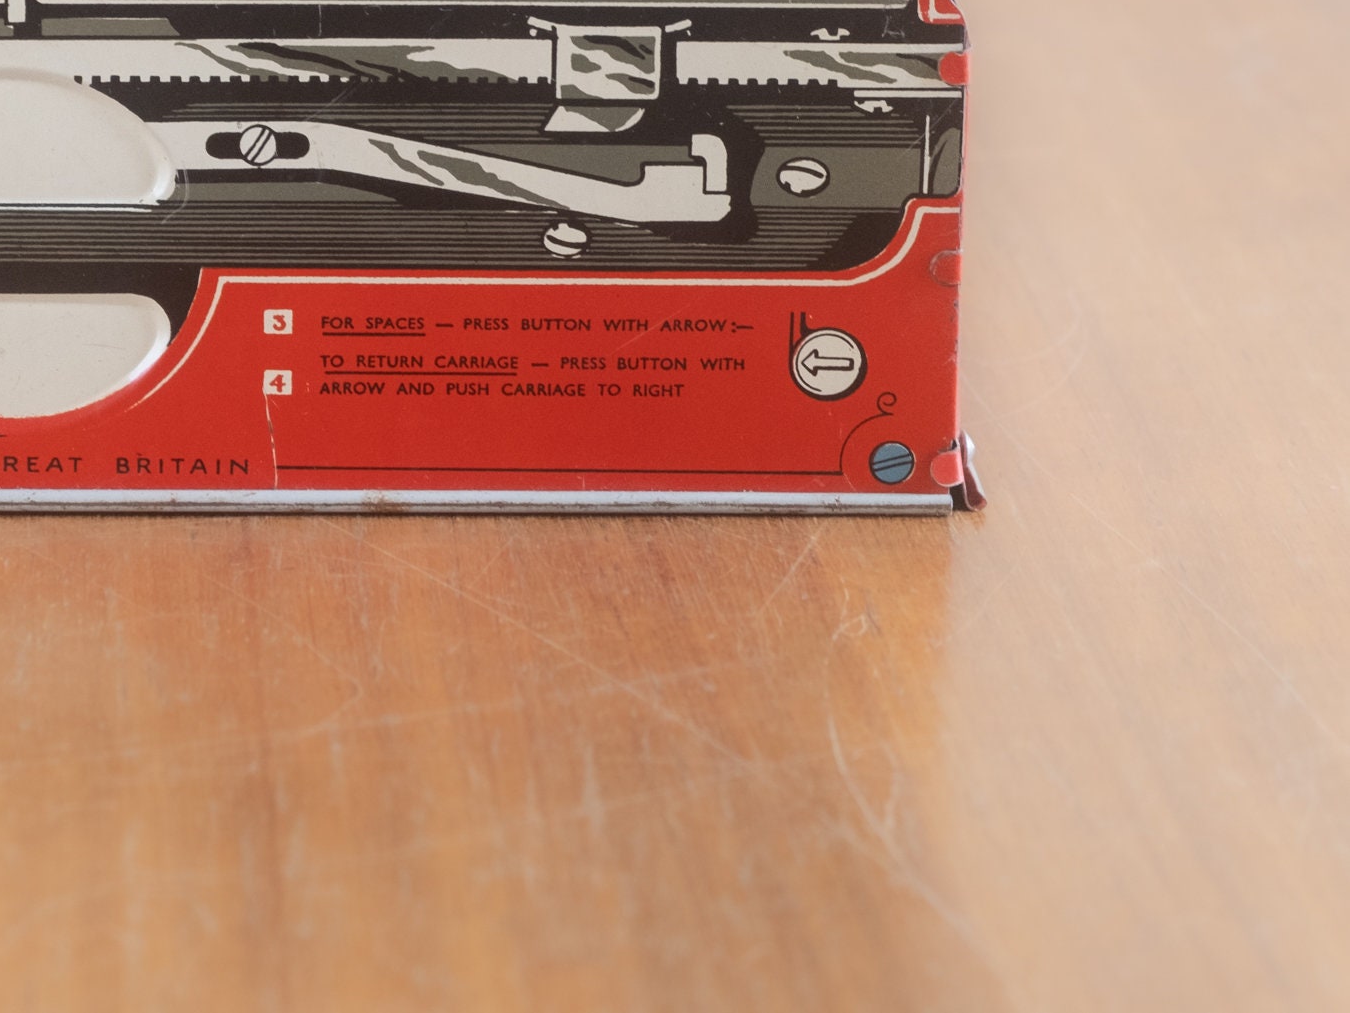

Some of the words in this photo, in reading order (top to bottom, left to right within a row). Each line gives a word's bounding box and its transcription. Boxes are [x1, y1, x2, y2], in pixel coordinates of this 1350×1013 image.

[272, 314, 287, 331] 3
[321, 316, 355, 330] FOR
[365, 316, 425, 331] SPACES
[462, 317, 510, 332] PRESS
[520, 317, 592, 332] BUTTON
[602, 318, 650, 333] WITH
[320, 354, 344, 369] TO
[356, 355, 423, 370] RETURN
[434, 355, 519, 370] CARRIAGE
[559, 355, 607, 371] PRESS
[616, 355, 688, 372] BUTTON
[699, 356, 746, 372] WITH
[269, 374, 286, 393] 4
[318, 381, 386, 396] ARROW
[395, 381, 436, 397] AND
[445, 381, 490, 397] PUSH
[500, 382, 587, 398] CARRIAGE
[597, 382, 622, 397] TO
[631, 382, 686, 399] RIGHT
[114, 456, 250, 476] BRITAIN
